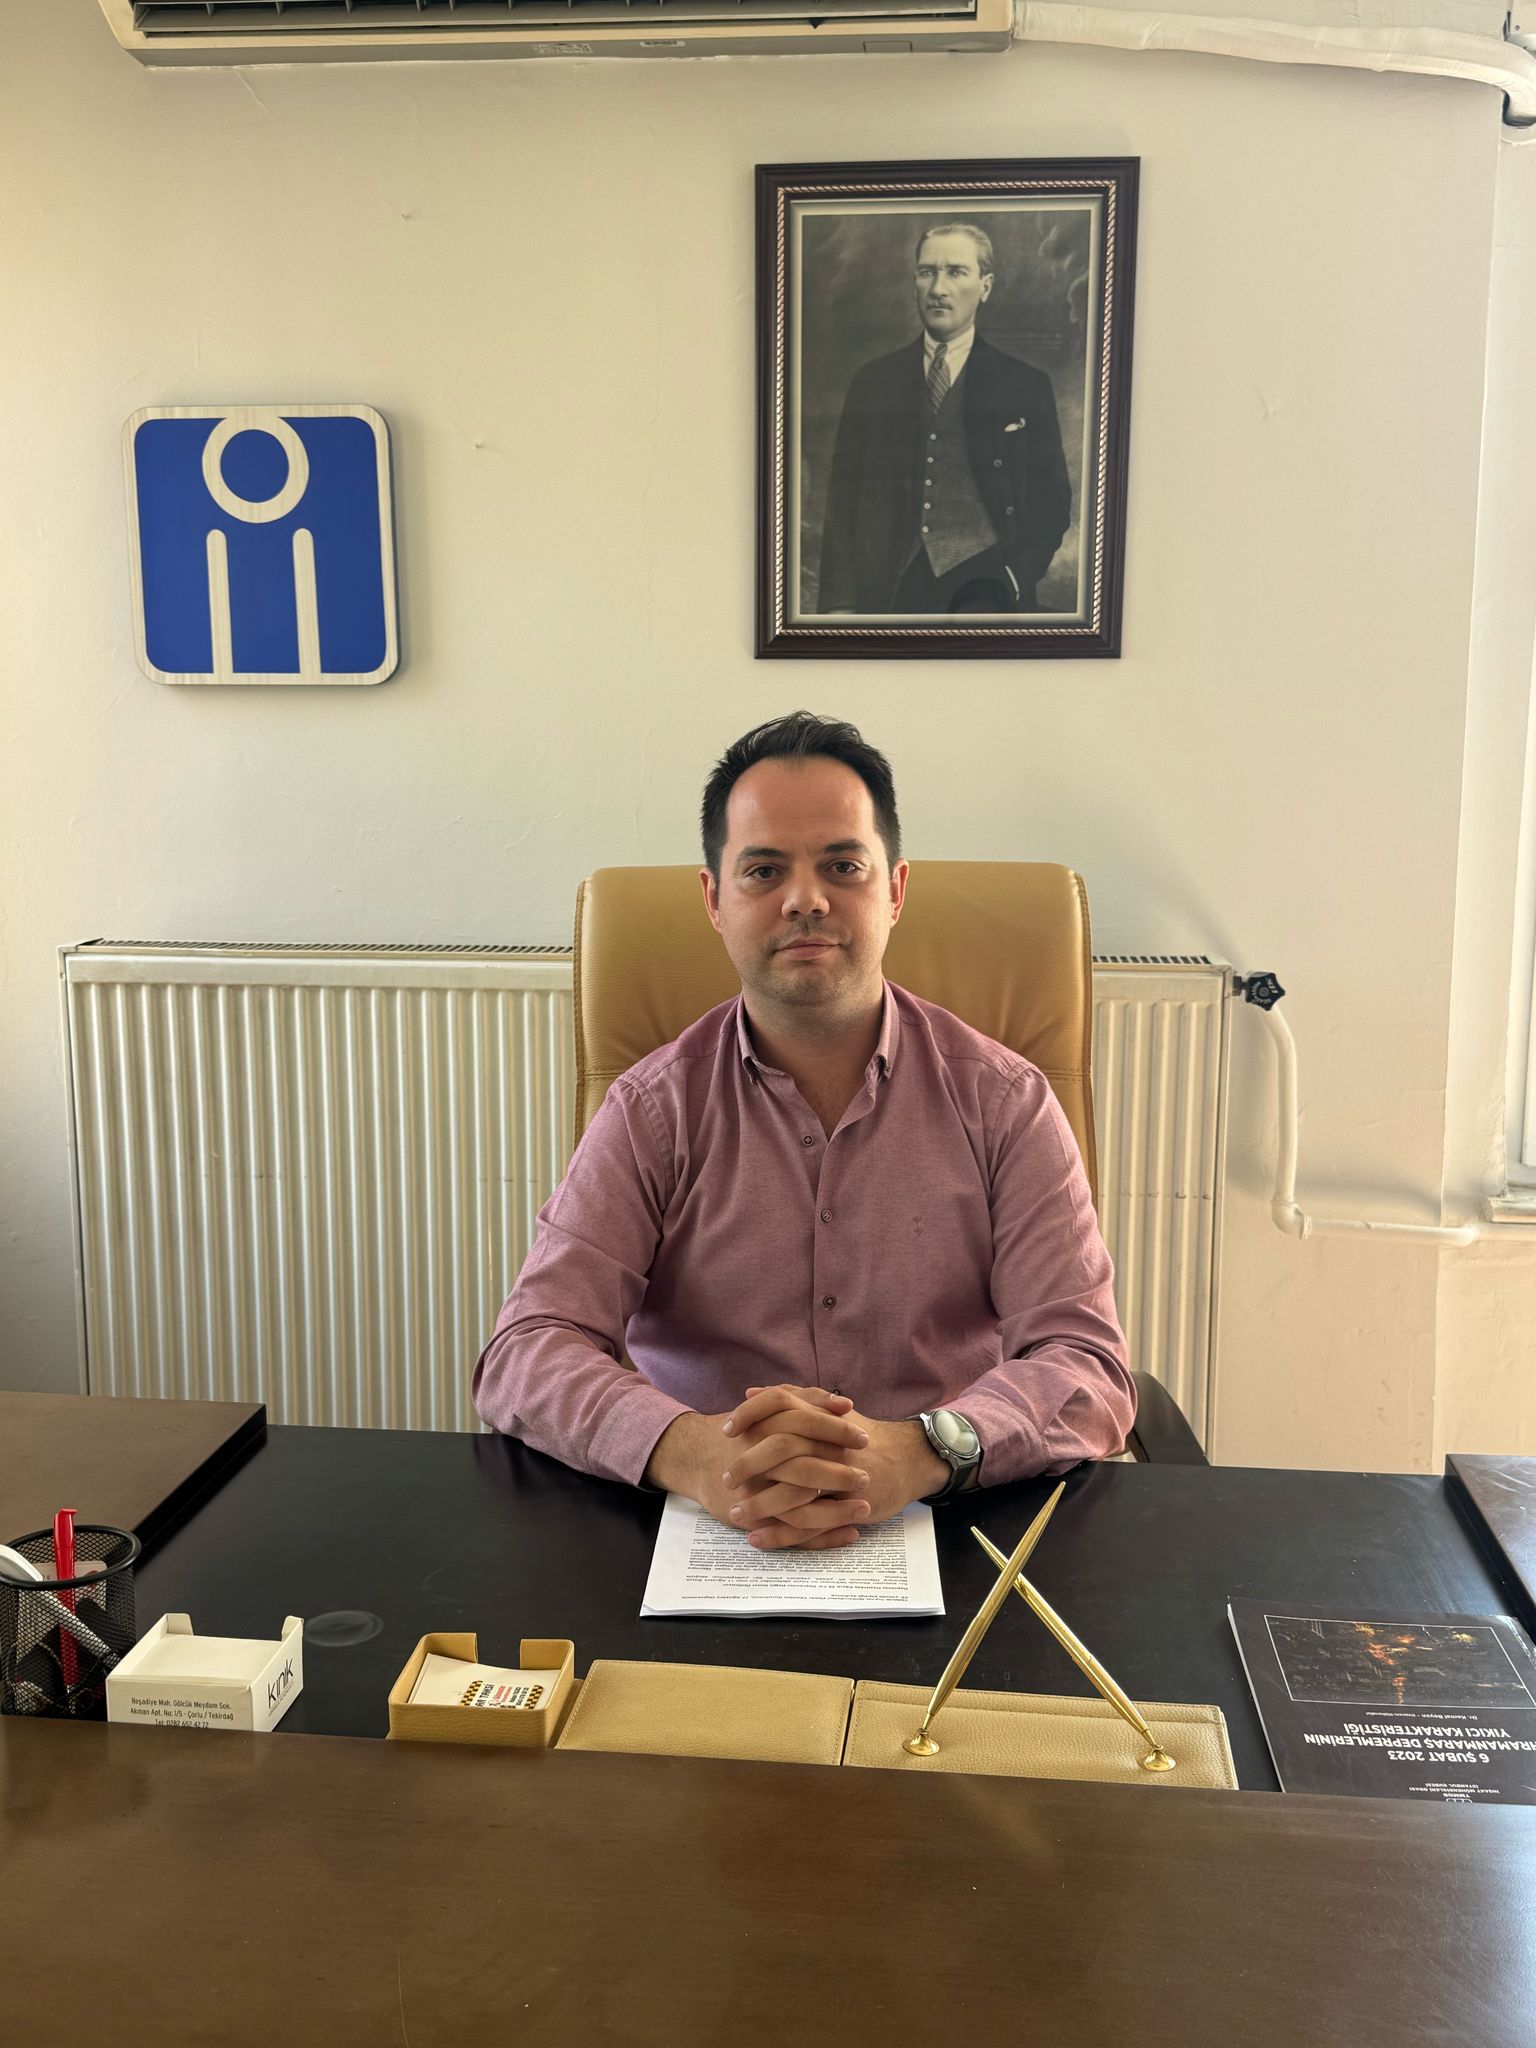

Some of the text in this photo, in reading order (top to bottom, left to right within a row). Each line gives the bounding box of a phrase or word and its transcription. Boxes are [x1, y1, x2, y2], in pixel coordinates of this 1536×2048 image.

[131, 1697, 158, 1707] Reşadiye
[158, 1699, 172, 1707] Mah.
[172, 1699, 193, 1708] Gölcük
[150, 1709, 163, 1717] Apt.
[187, 1711, 203, 1719] Çorlu
[208, 1711, 234, 1721] Tekirdağ
[1343, 1723, 1511, 1739] YIKICI KARAKTERİSTİĞİ
[1303, 1733, 1422, 1748] DEPREMLERİNİN
[1387, 1750, 1490, 1763] 6 ŞUBAT 2023
